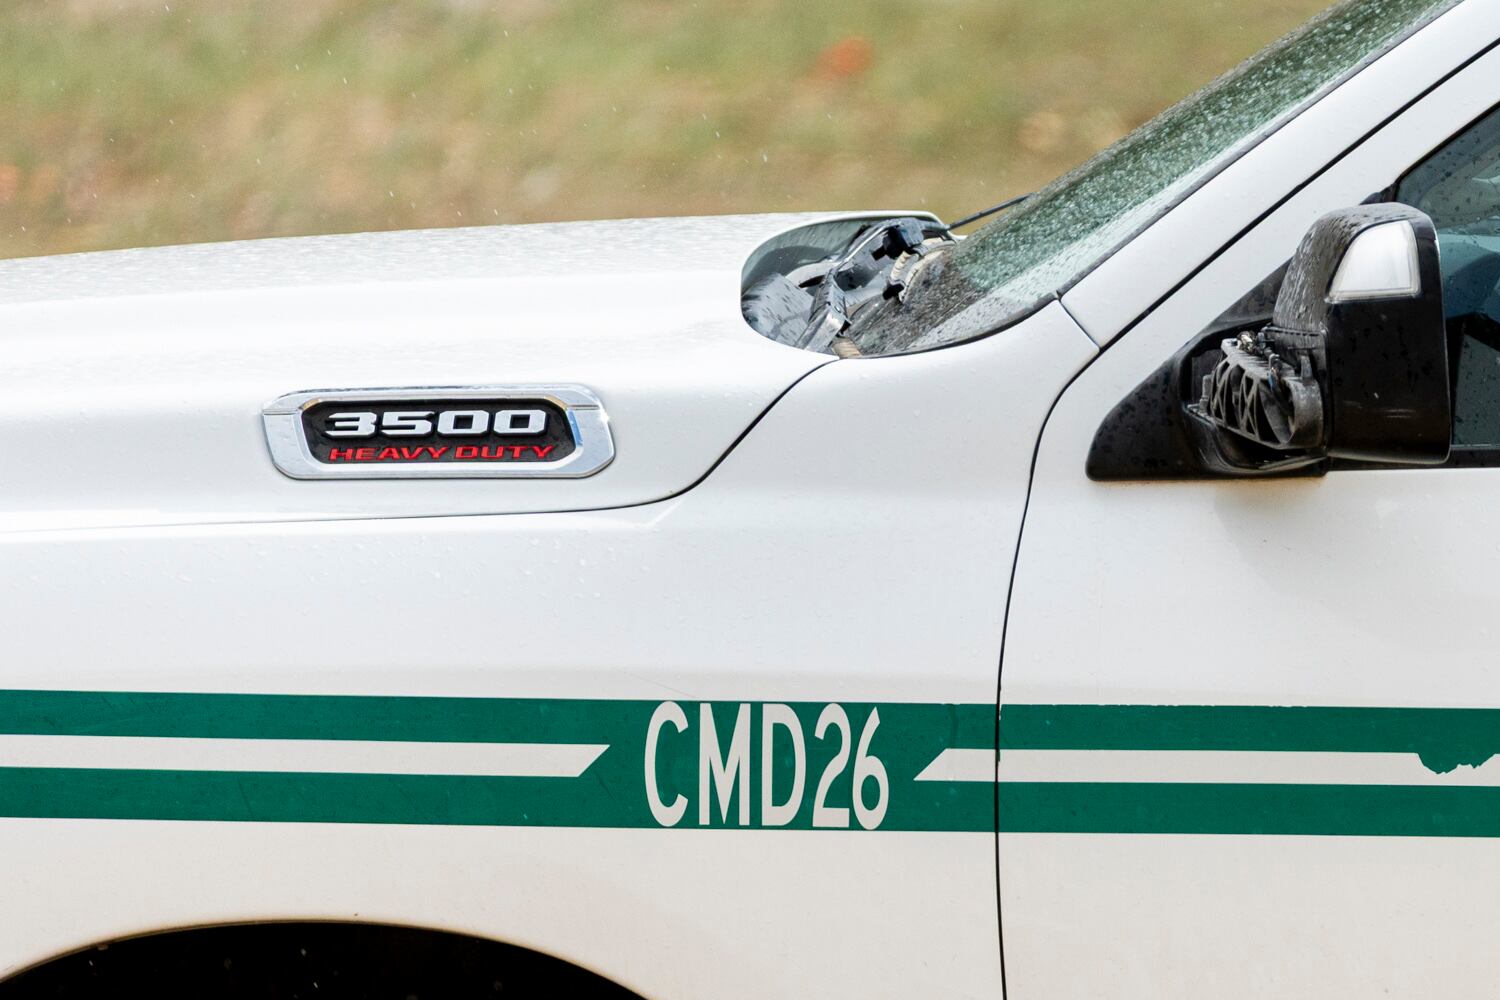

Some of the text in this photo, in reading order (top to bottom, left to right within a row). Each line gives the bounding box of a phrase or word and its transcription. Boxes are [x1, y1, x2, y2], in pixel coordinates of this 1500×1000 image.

[323, 409, 547, 437] 3500
[328, 445, 556, 462] HEAVY DUTY
[644, 700, 890, 831] CMD26
